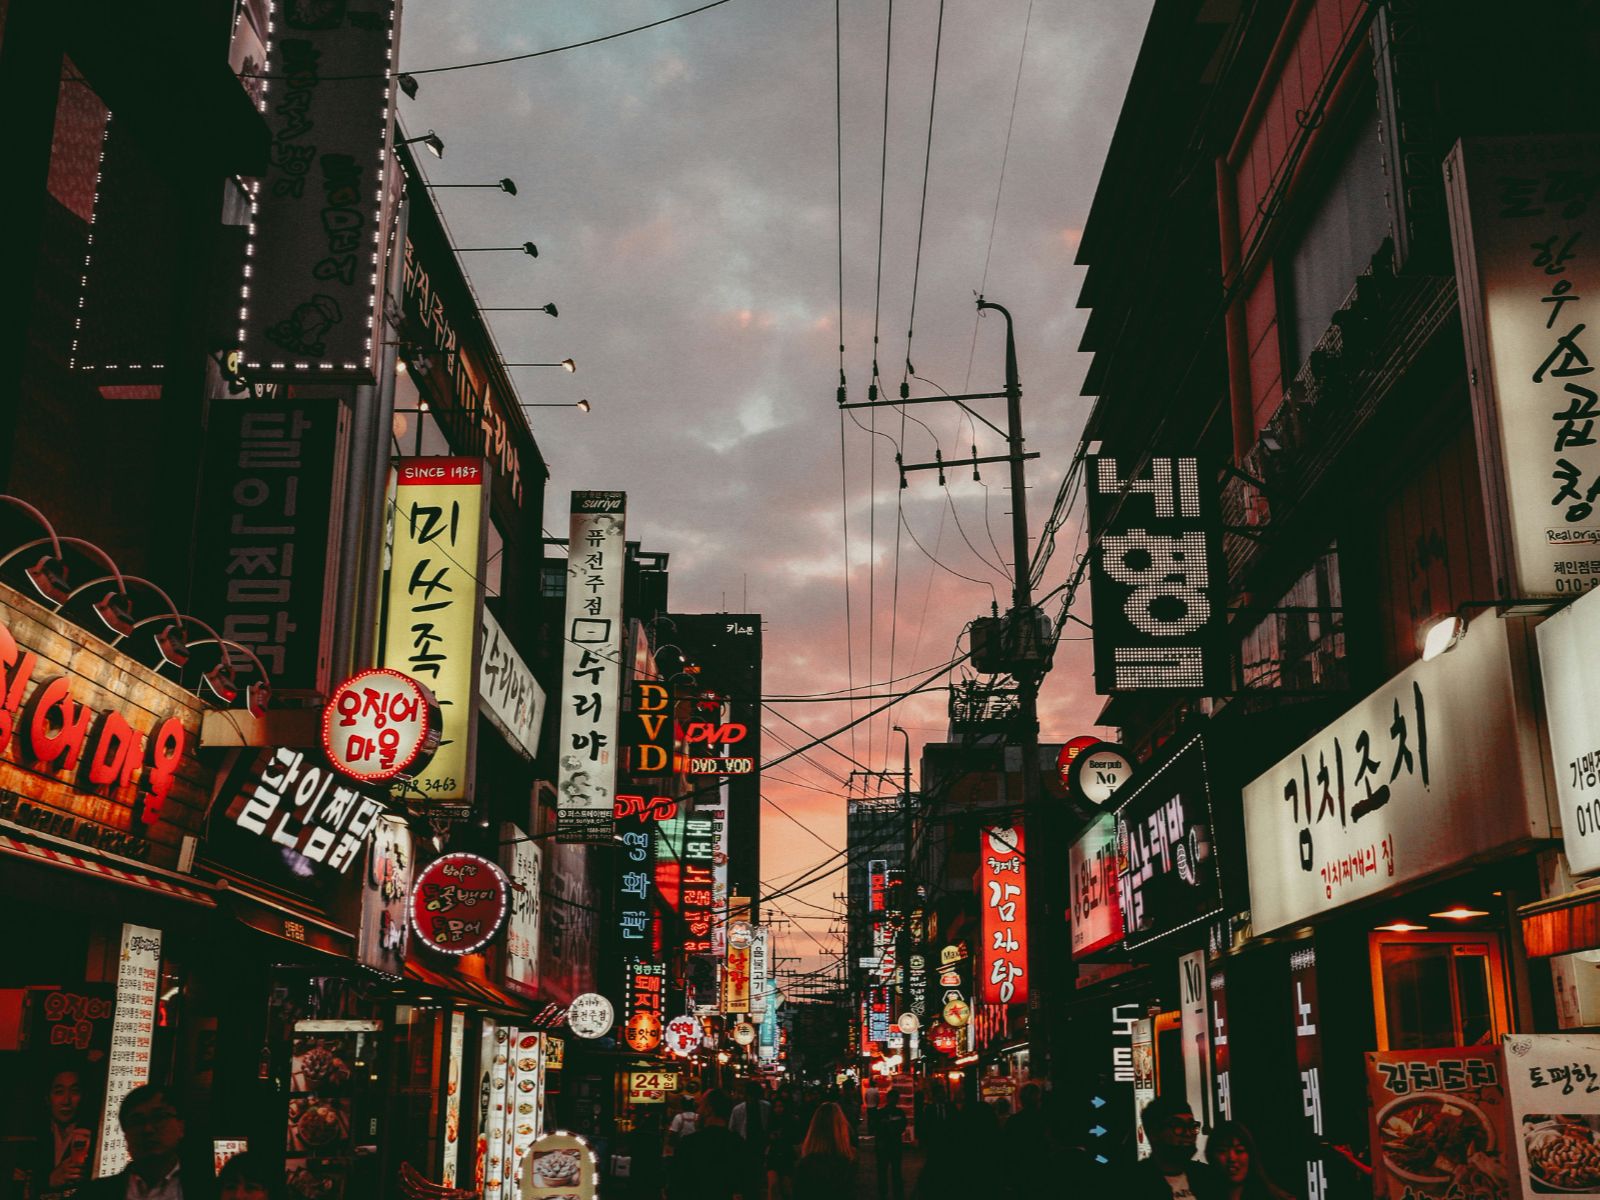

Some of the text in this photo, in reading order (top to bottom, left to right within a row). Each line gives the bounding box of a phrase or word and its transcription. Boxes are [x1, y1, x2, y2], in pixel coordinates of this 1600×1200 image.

[404, 466, 481, 480] SINCE 1987
[582, 499, 621, 512] suriya
[1547, 530, 1570, 542] Real
[584, 529, 606, 615] 퓨전주점
[337, 688, 418, 729] 오징어
[572, 648, 607, 761] 수리야
[637, 684, 670, 771] DVD
[686, 722, 748, 745] DVD
[346, 728, 399, 769] 마을
[1089, 760, 1106, 769] Beer
[424, 777, 457, 793] 3463
[1284, 681, 1430, 873] 김치조치
[614, 793, 678, 824] DVD
[1381, 834, 1395, 877] 집
[988, 881, 1023, 1003] 감자탕
[1184, 959, 1202, 1004] No
[635, 1074, 660, 1089] 24
